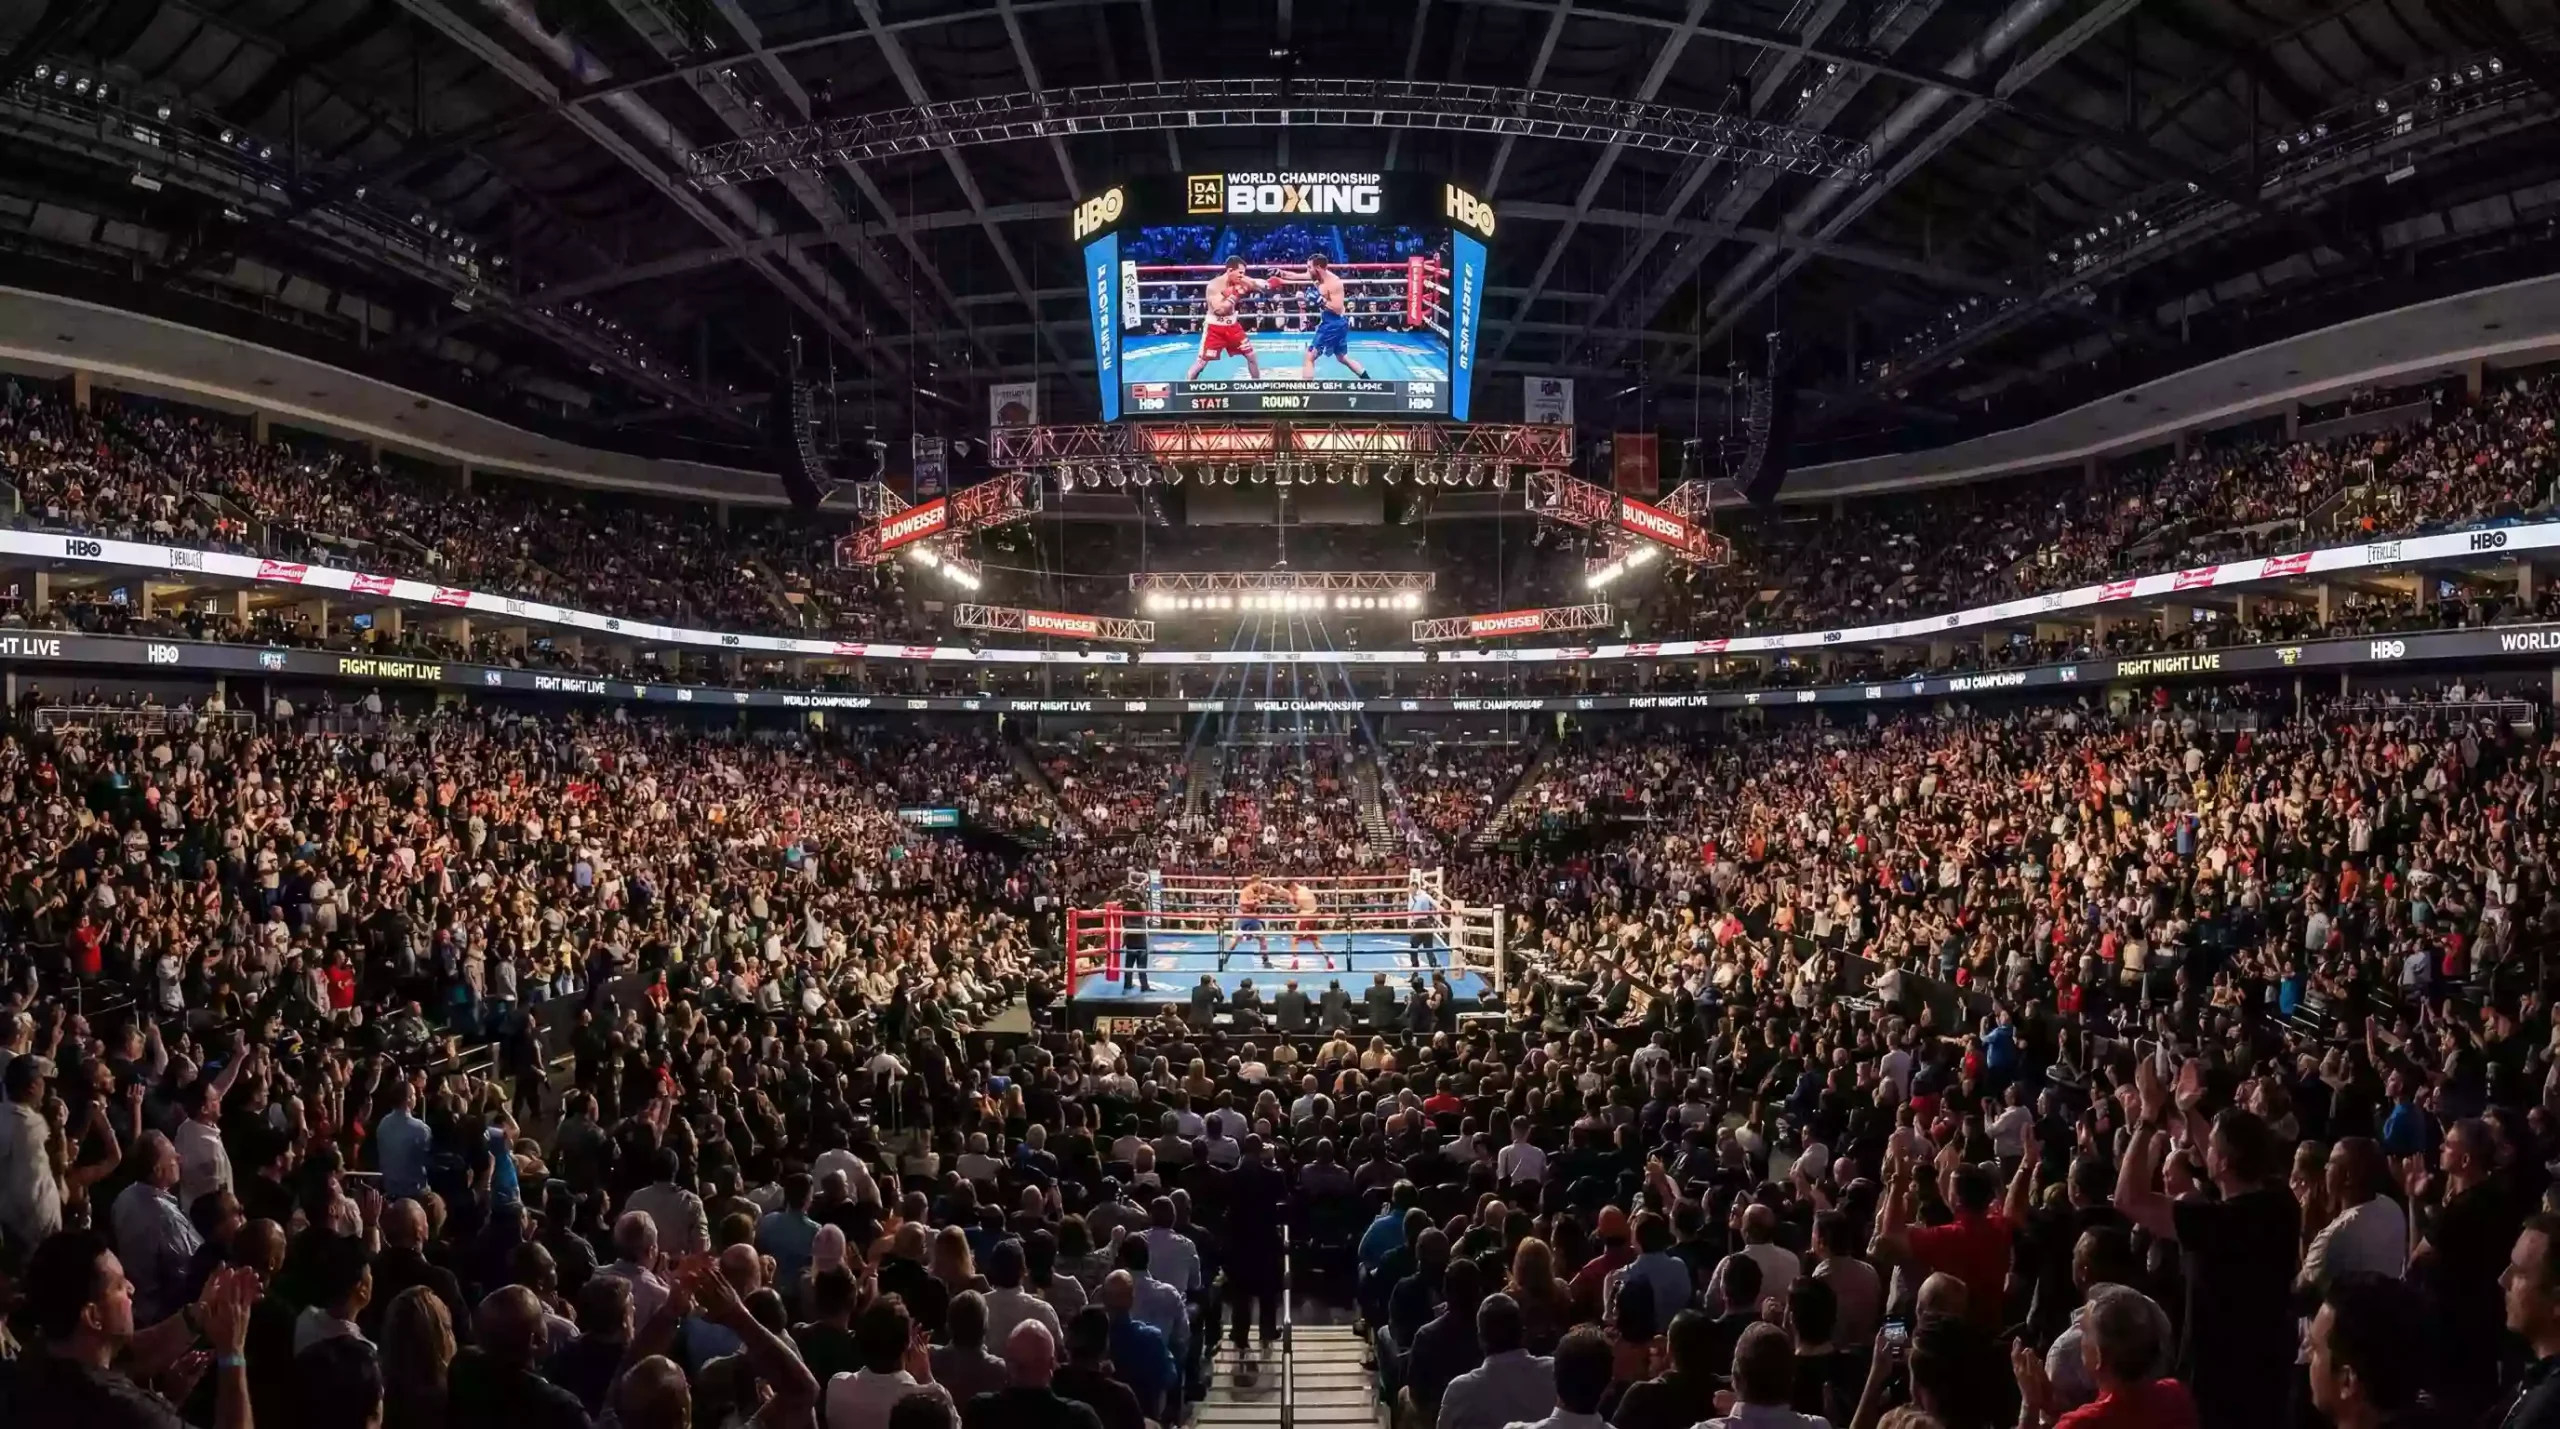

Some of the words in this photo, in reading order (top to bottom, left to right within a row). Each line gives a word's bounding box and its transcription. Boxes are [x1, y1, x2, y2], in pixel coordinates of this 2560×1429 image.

[1228, 173, 1276, 184] WORLD
[1280, 173, 1381, 184] CHAMPIONSHIP
[1228, 185, 1381, 214] BOXING
[1073, 187, 1125, 240] HBO
[1446, 183, 1496, 238] HBO
[1190, 383, 1228, 391] WORLD
[1262, 396, 1300, 408] ROUND
[1302, 396, 1310, 408] 7
[881, 505, 945, 542] BUDWEISER
[1622, 503, 1684, 541] BUDWEISER
[66, 538, 102, 557] HBO
[2470, 531, 2508, 550] HBO
[1028, 615, 1097, 633] BUDWEISER
[1472, 615, 1540, 632] BUDWEISER
[23, 638, 60, 656] LIVE
[2371, 640, 2406, 660] HBO
[2501, 632, 2560, 651] WORLD
[148, 644, 179, 663] HBO
[339, 658, 377, 675] FIGHT
[378, 661, 415, 679] NIGHT
[416, 664, 442, 680] LIVE
[2117, 660, 2151, 676] FIGHT
[2153, 657, 2190, 673] NIGHT
[2192, 654, 2220, 670] LIVE
[535, 676, 561, 690] FIGHT
[587, 681, 605, 694] LIVE
[1011, 701, 1038, 711] FIGHT
[1071, 701, 1091, 711] LIVE
[1629, 697, 1656, 708] FIGHT
[1658, 696, 1687, 707] NIGHT
[1687, 695, 1708, 706] LIVE
